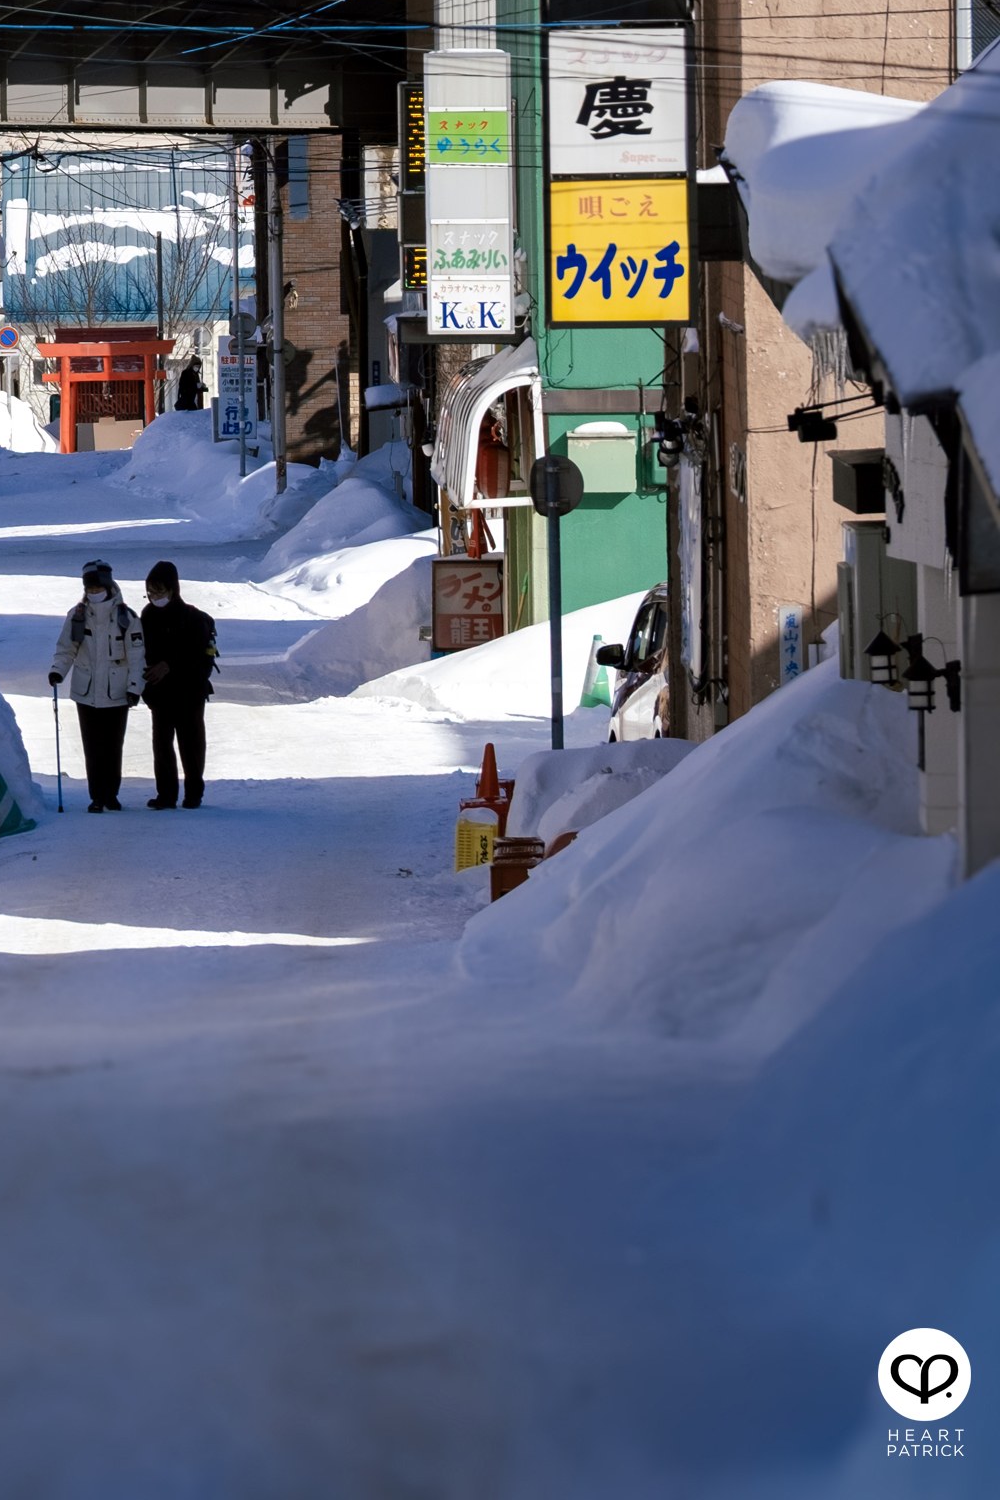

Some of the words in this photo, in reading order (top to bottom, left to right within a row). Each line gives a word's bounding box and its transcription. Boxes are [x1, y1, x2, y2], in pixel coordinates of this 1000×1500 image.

[567, 48, 668, 65] スナック
[575, 75, 654, 140] 慶
[438, 120, 489, 131] スナック
[436, 137, 502, 155] ゆうらく
[619, 150, 656, 165] Super
[579, 194, 659, 219] 唄ごえ
[443, 230, 499, 246] スナック
[433, 248, 508, 270] ふあみりい
[556, 240, 685, 300] ウイッチ
[220, 356, 254, 365] 駐車止
[437, 572, 503, 610] ラーメン
[450, 617, 490, 645] 龍王
[784, 613, 799, 682] 嵐山中央
